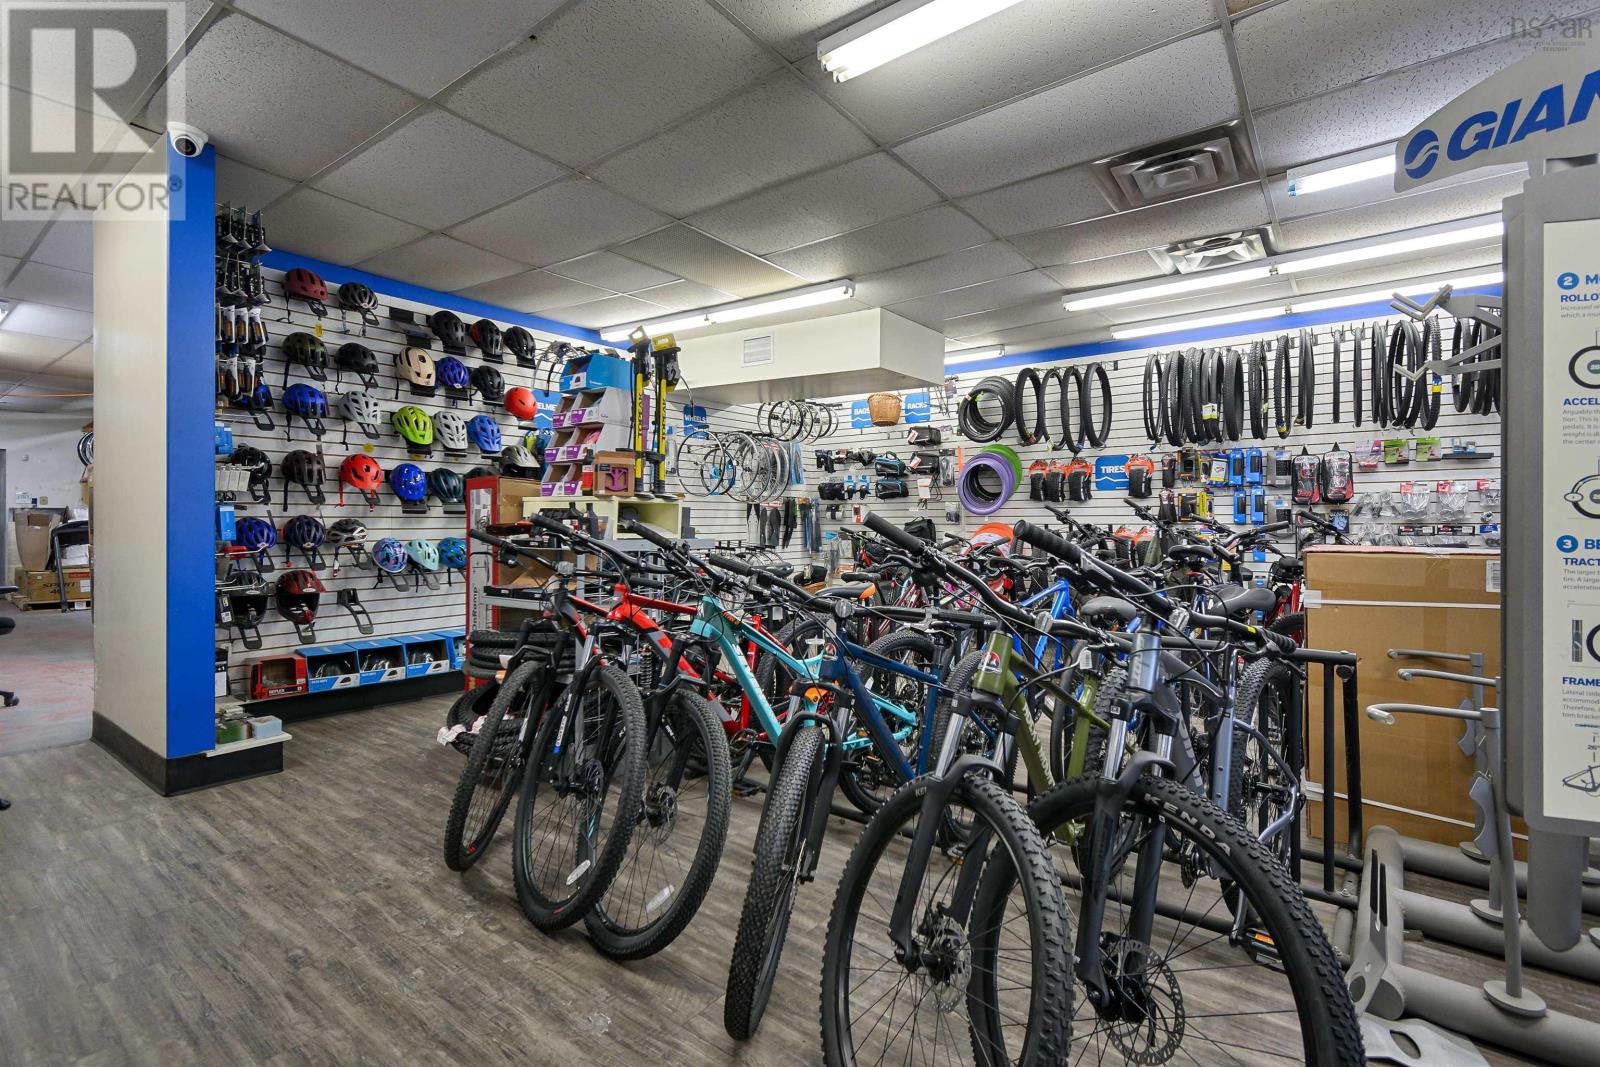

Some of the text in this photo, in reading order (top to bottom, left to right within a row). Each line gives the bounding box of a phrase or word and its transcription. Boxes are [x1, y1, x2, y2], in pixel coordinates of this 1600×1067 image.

[1563, 273, 1600, 286] 2 M
[1560, 293, 1600, 303] ROLLO
[1100, 465, 1125, 474] TIRES
[1562, 539, 1573, 549] 3
[1562, 676, 1600, 687] FRAME
[1144, 792, 1232, 857] KENDA
